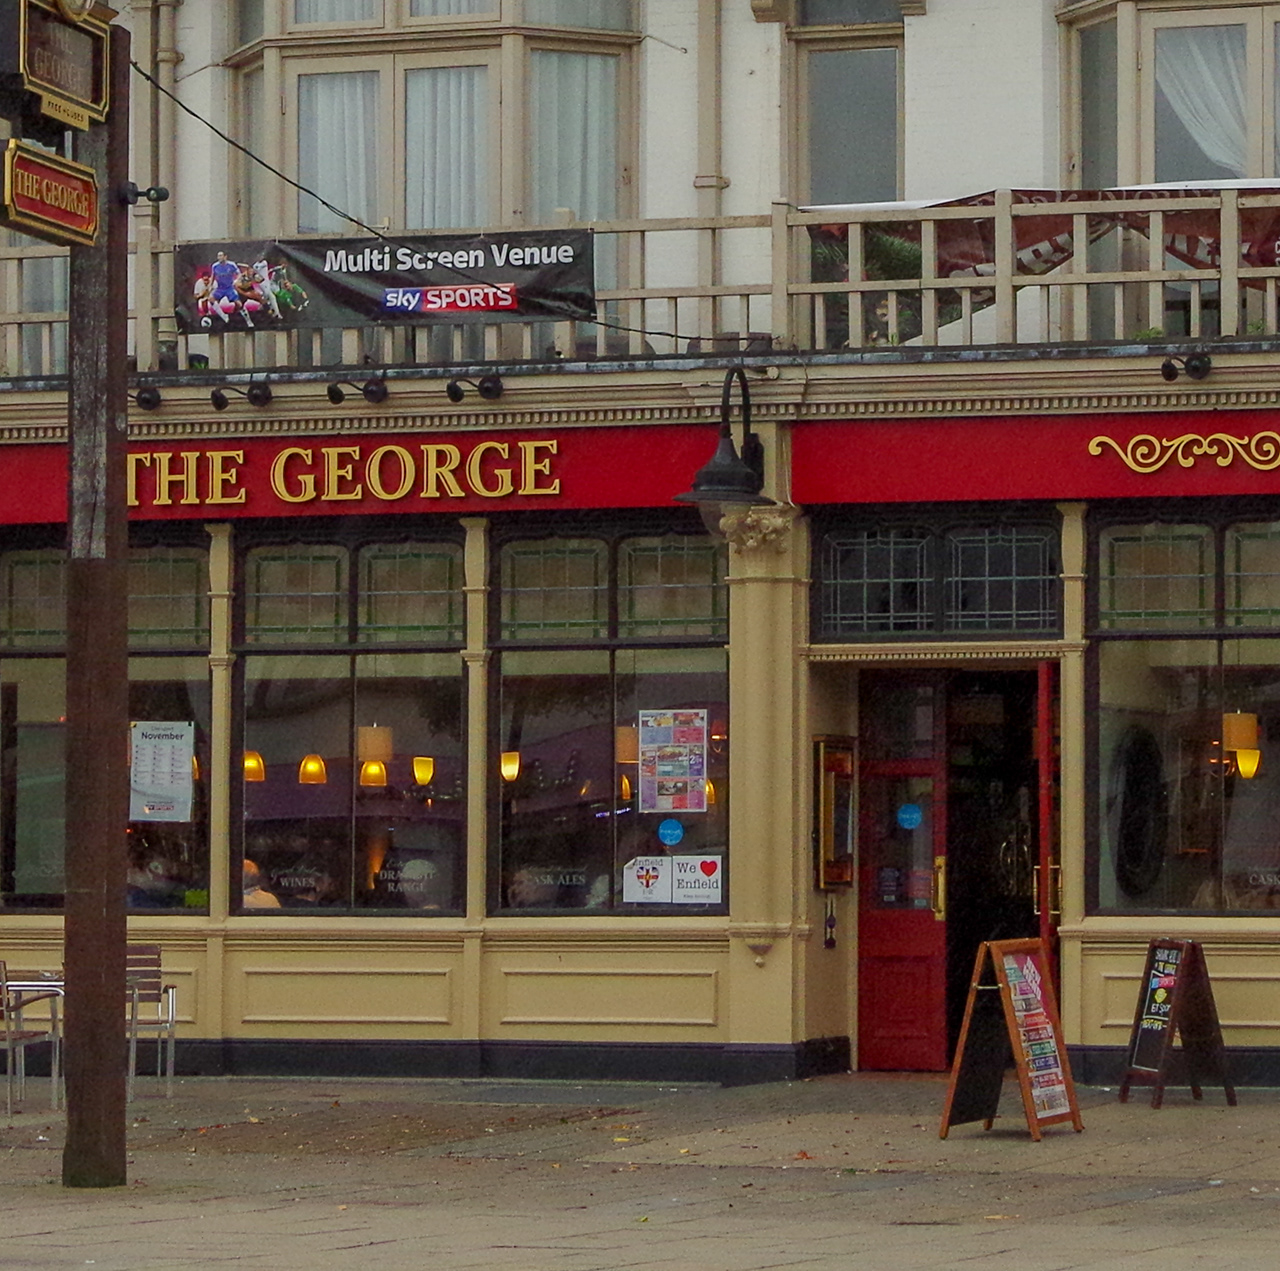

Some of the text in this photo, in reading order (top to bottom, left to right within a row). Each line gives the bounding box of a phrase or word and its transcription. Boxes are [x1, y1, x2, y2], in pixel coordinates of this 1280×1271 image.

[15, 168, 90, 219] THE GEORGE
[323, 243, 574, 273] Multi Screen Venue
[385, 287, 512, 310] sky SPORTS
[126, 439, 560, 506] THE GEORGE
[141, 732, 184, 740] November
[676, 862, 697, 873] We
[279, 877, 316, 887] WINES
[557, 874, 586, 884] ALES
[676, 879, 719, 889] Enfield
[1249, 873, 1280, 885] CASK
